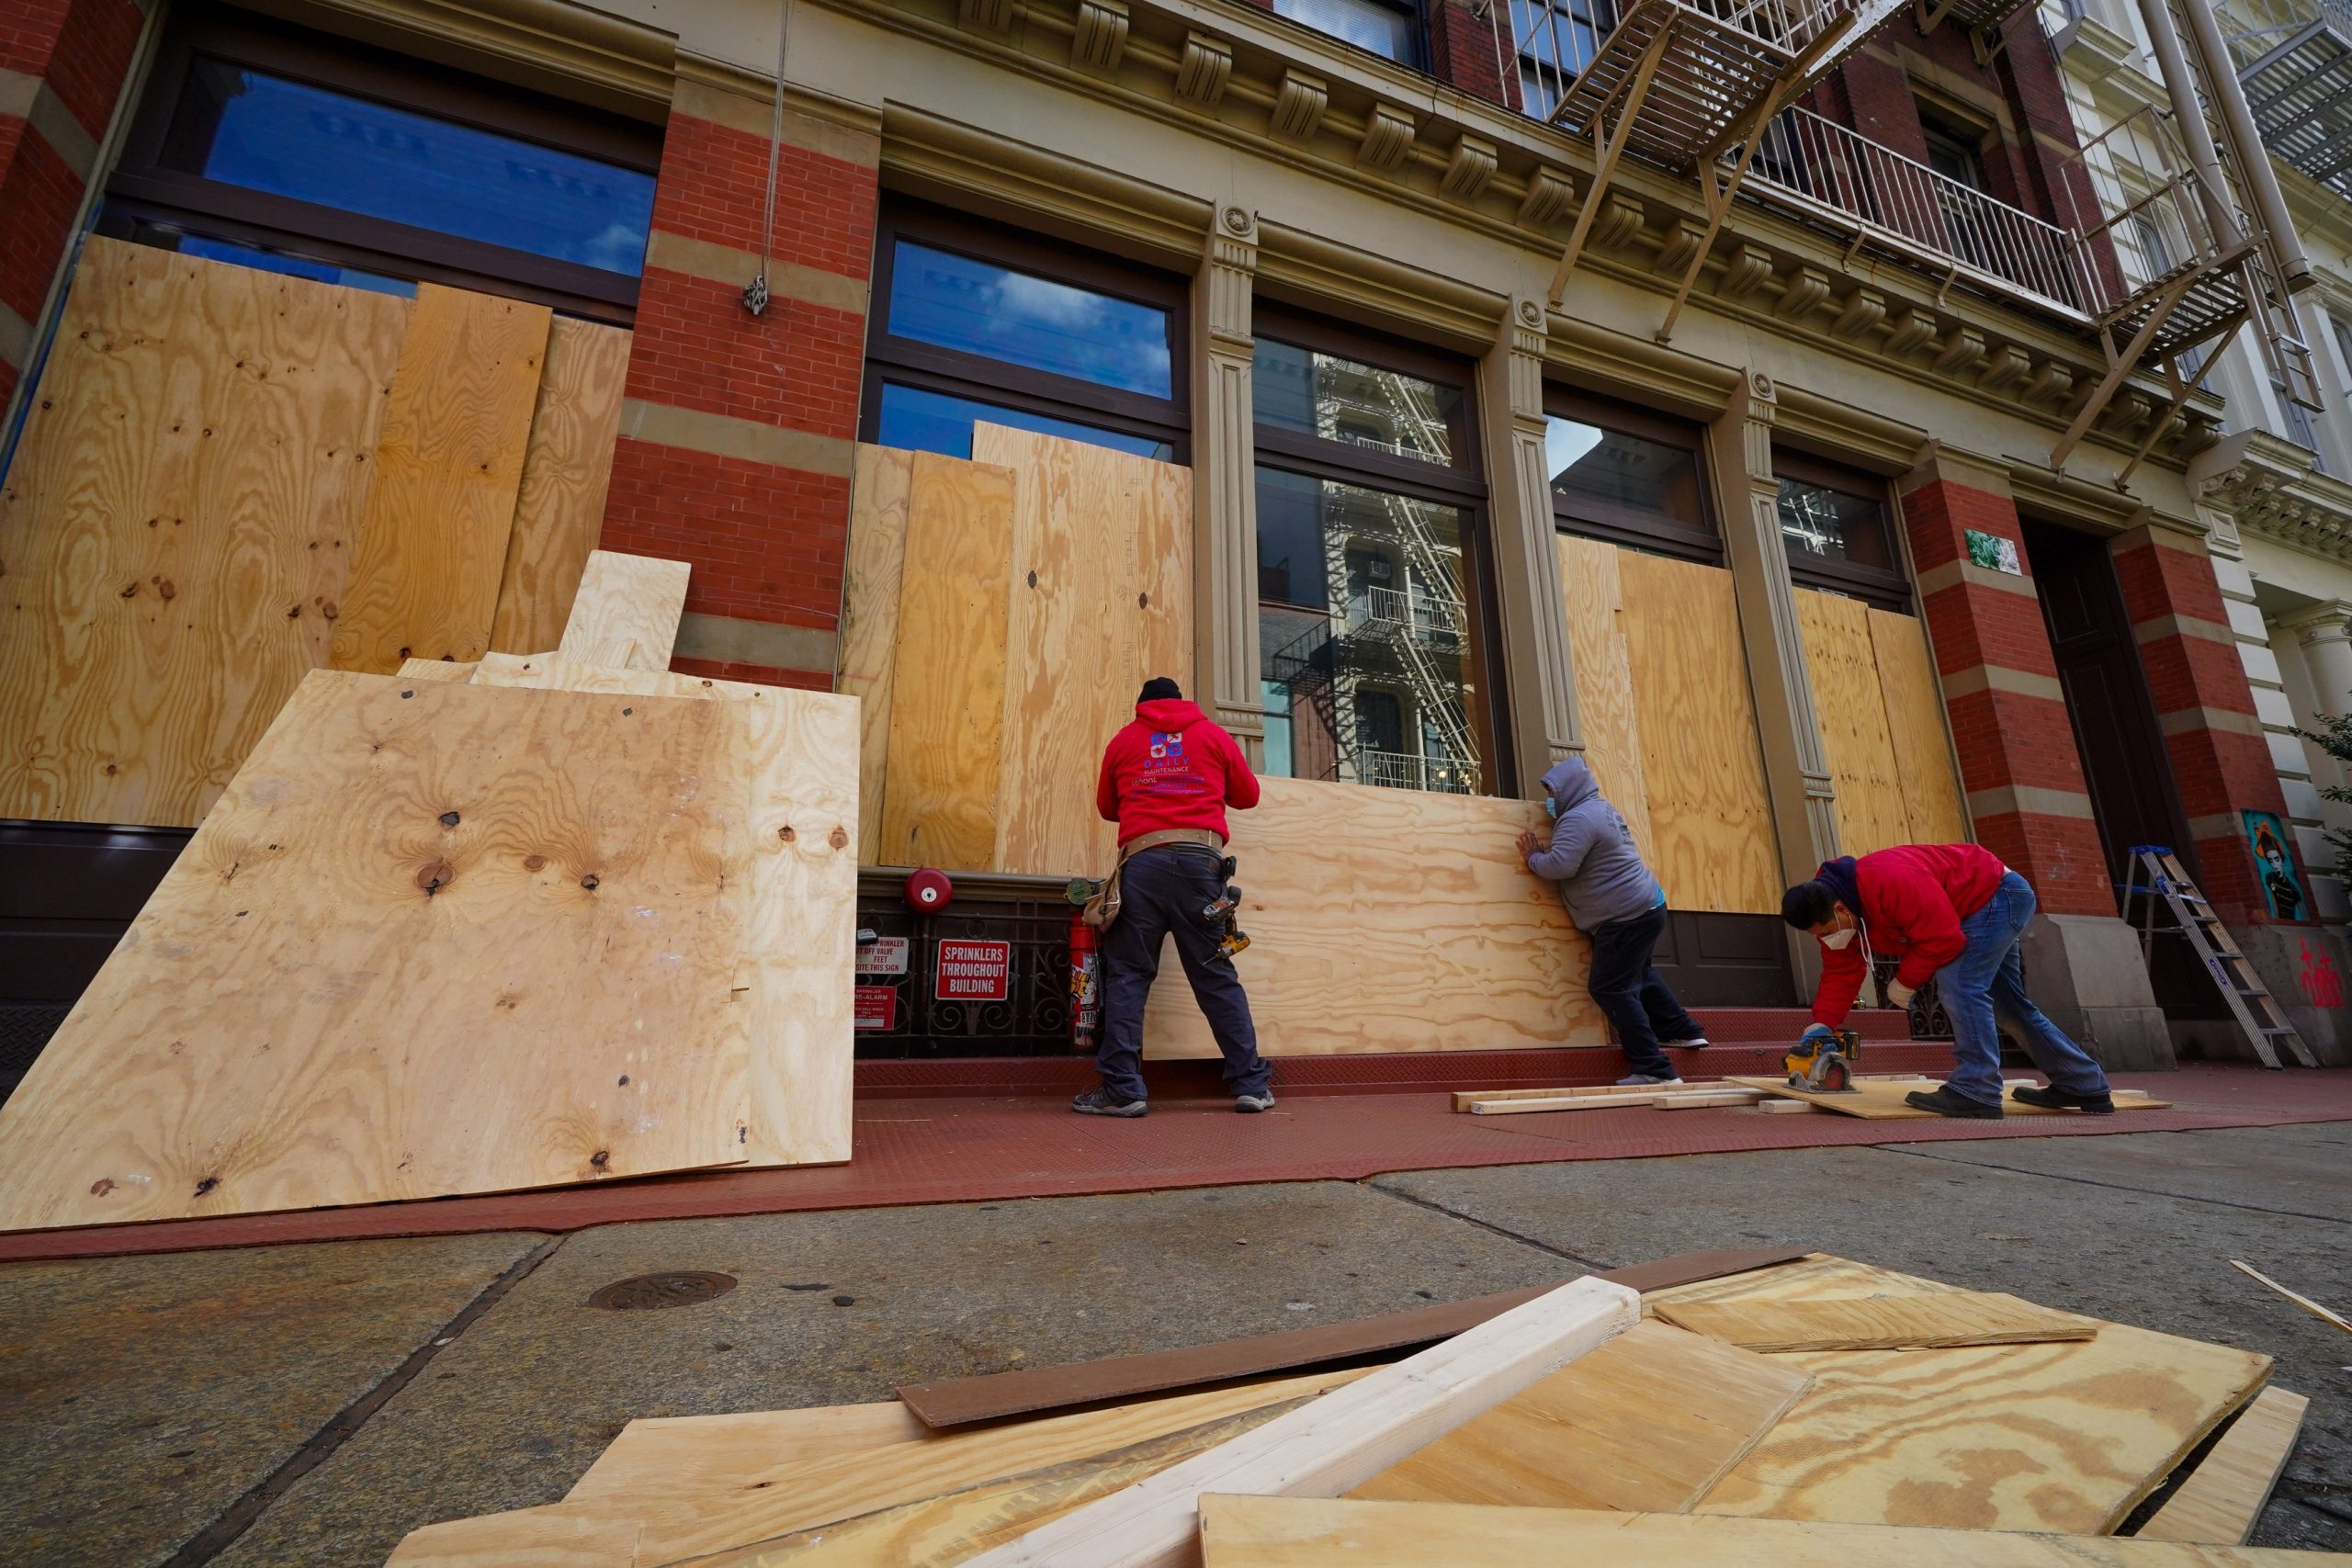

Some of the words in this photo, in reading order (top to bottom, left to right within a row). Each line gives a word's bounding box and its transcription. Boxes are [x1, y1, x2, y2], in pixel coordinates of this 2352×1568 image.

[1144, 757, 1189, 769] DAILY
[1144, 766, 1189, 774] MAINTENANCE
[945, 947, 1003, 961] SPRINKLERS
[942, 962, 1005, 977] THROUGHOUT
[949, 978, 995, 993] BUILDING
